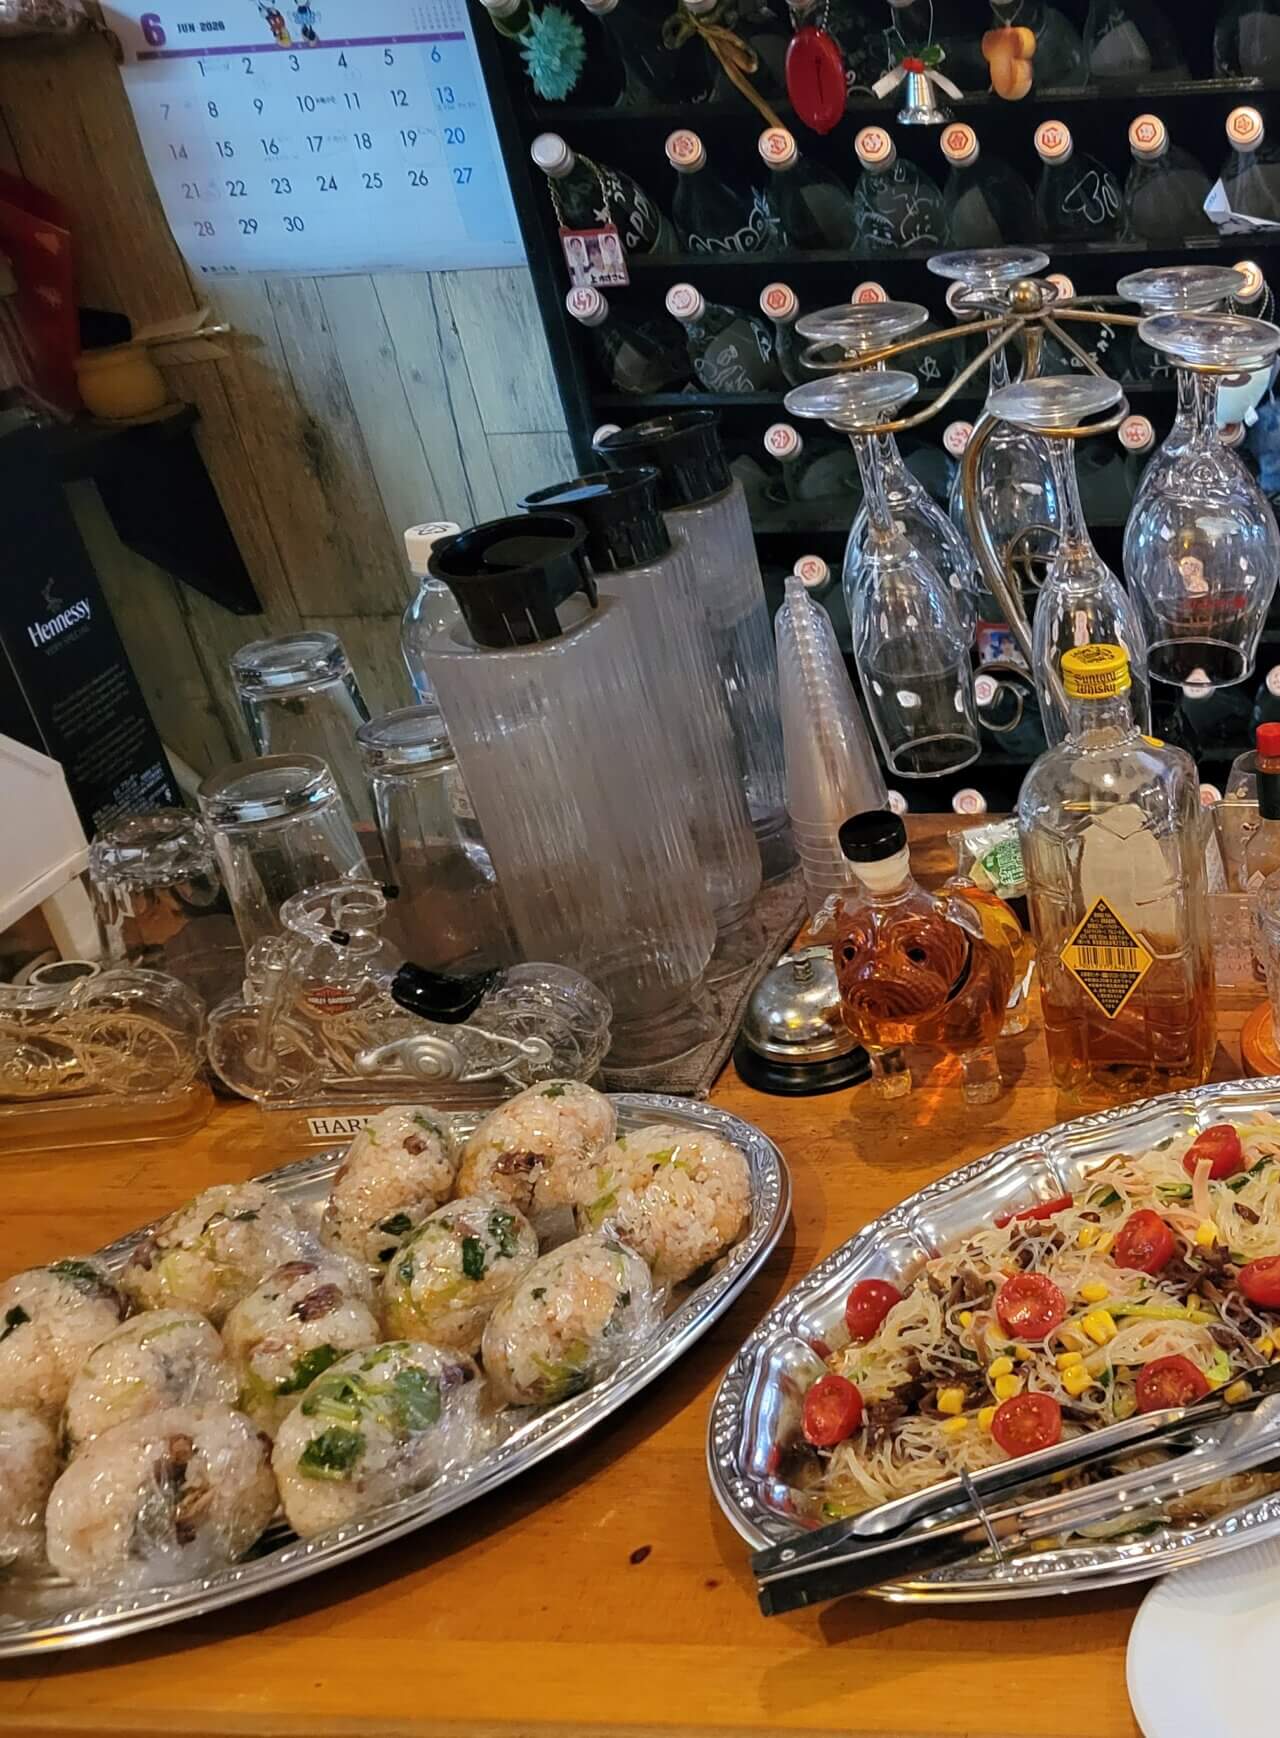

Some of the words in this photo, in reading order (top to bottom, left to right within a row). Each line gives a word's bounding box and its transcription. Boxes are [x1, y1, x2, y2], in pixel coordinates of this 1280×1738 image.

[140, 13, 166, 47] 6
[198, 60, 206, 77] 1
[242, 57, 254, 75] 2
[289, 55, 300, 72] 3
[337, 52, 348, 69] 4
[384, 49, 394, 66] 5
[431, 46, 441, 64] 6
[160, 104, 170, 121] 7
[208, 101, 219, 119] 8
[254, 98, 264, 116] 9
[298, 96, 315, 113] 10
[344, 93, 360, 110] 11
[390, 89, 409, 107] 12
[437, 87, 455, 104] 13
[170, 143, 188, 161] 14
[216, 141, 234, 158] 15
[261, 138, 279, 156] 16
[306, 135, 323, 153] 17
[354, 133, 372, 150] 18
[400, 130, 417, 148] 19
[445, 127, 465, 145] 20
[182, 183, 200, 200] 21
[225, 180, 247, 197] 22
[271, 178, 292, 195] 23
[316, 175, 338, 192] 24
[362, 172, 383, 190] 25
[408, 169, 429, 187] 26
[454, 167, 472, 185] 27
[194, 220, 215, 237] 28
[238, 218, 258, 236] 29
[283, 216, 304, 233] 30
[27, 597, 92, 648] Hennessy
[1074, 672, 1116, 684] Suntory
[1075, 680, 1116, 694] Whisky
[311, 1117, 368, 1136] HAR
